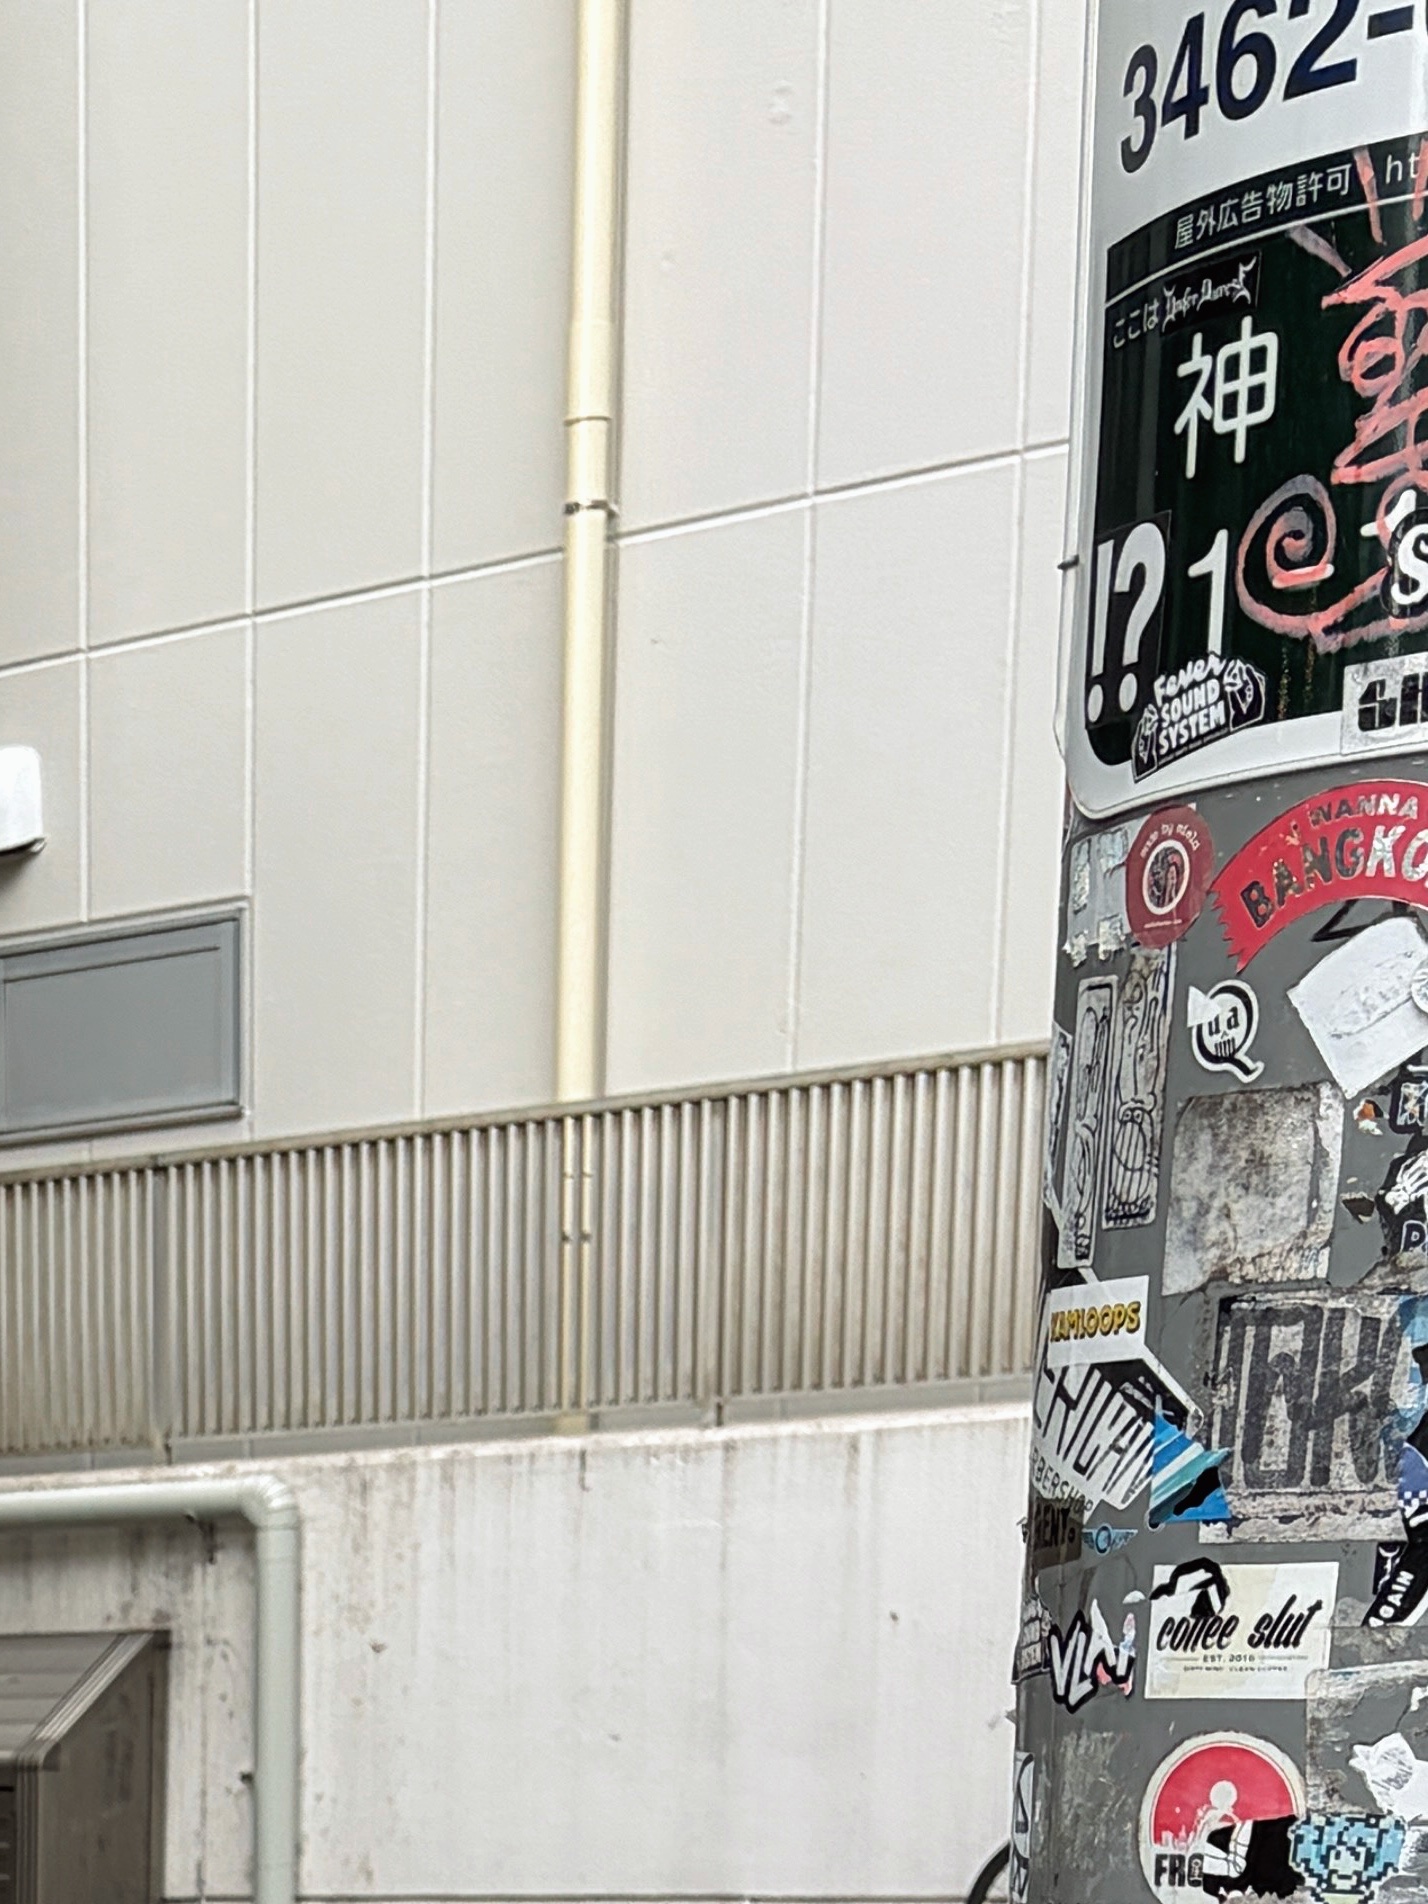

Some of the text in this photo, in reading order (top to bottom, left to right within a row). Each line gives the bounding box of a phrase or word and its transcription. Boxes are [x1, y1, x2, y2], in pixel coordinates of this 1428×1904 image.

[1120, 0, 1428, 174] 3462-
[1175, 163, 1352, 249] 屋外広告物許可
[1112, 299, 1159, 349] ここは
[1158, 699, 1227, 756] SYSTEM
[1161, 677, 1221, 729] SOUND
[1308, 792, 1419, 829] WANNA
[1247, 1593, 1323, 1650] slut
